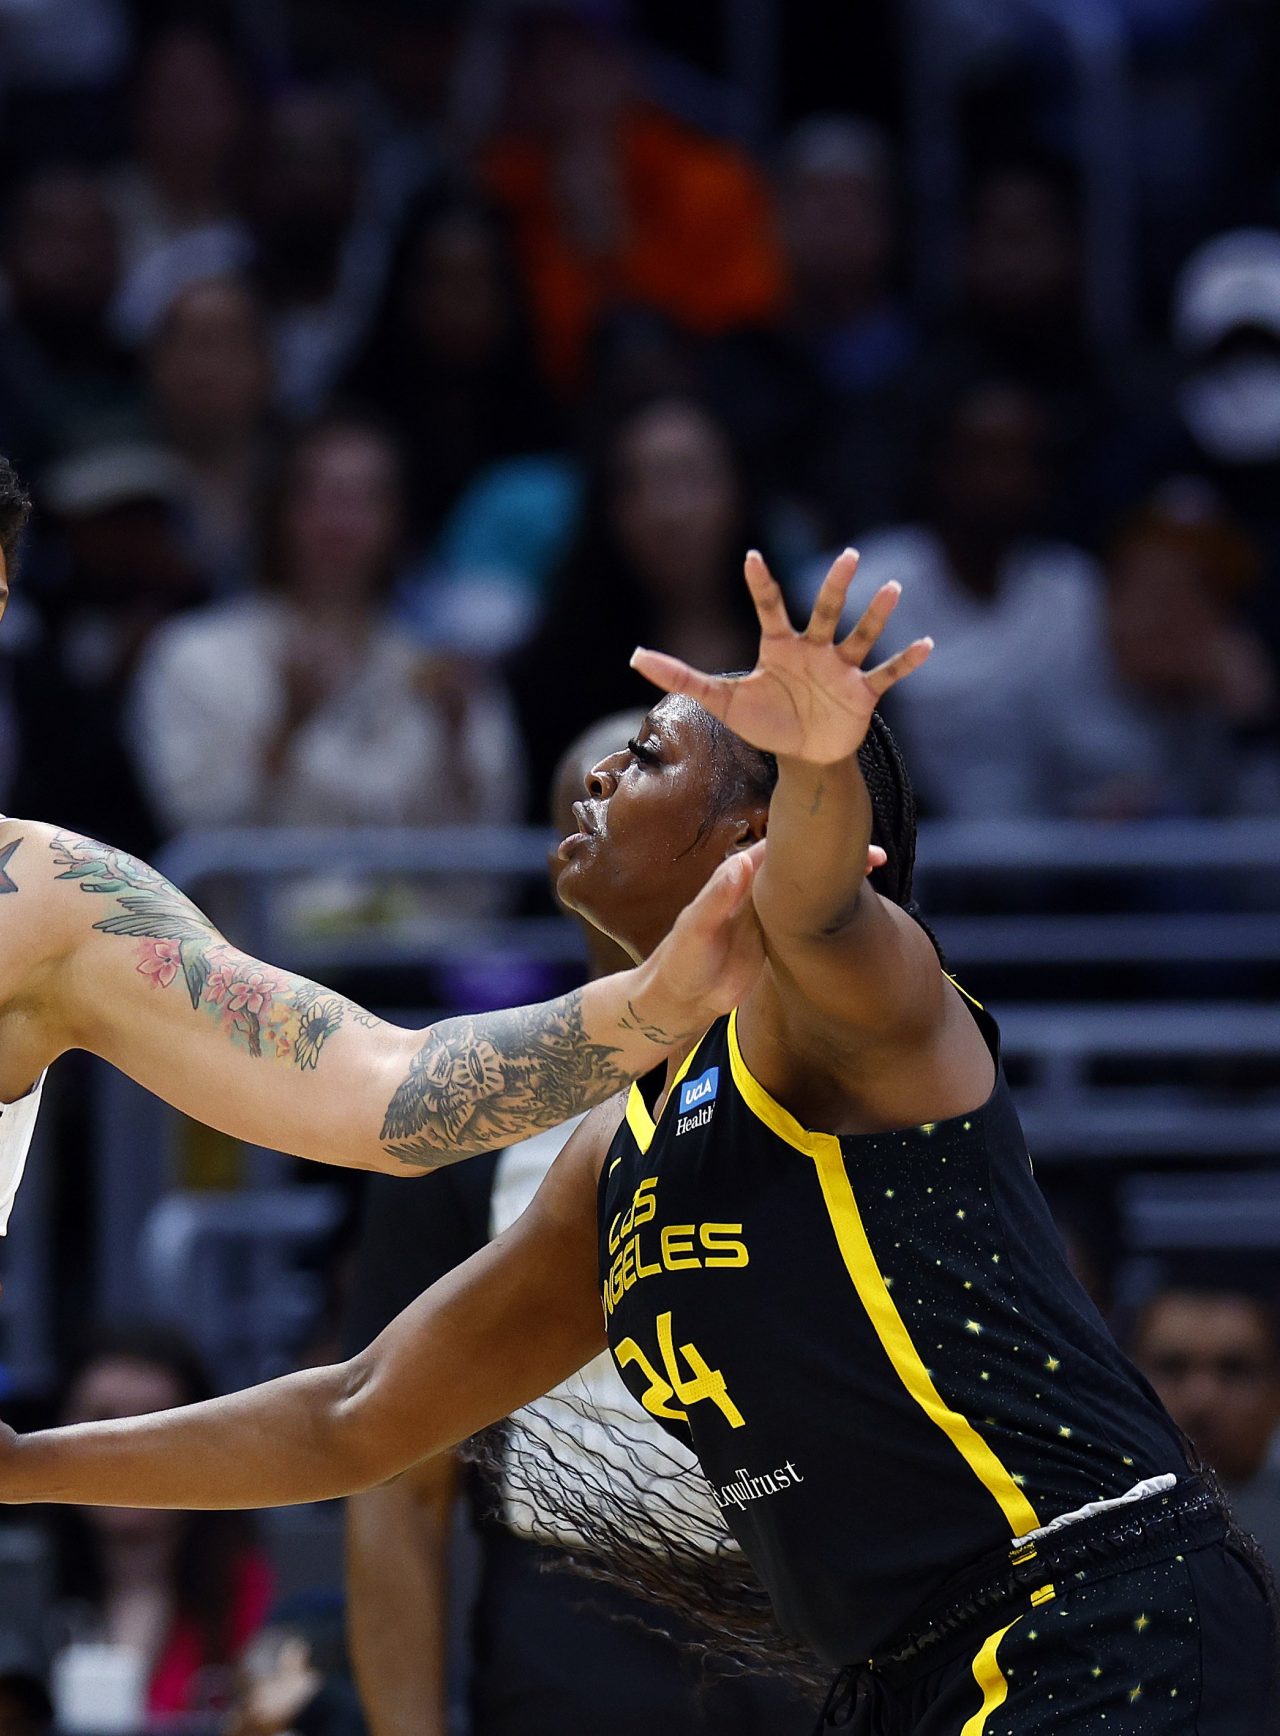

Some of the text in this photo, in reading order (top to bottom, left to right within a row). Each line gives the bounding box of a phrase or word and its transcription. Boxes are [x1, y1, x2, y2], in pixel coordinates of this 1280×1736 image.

[686, 1078, 712, 1105] UCLA
[601, 1222, 750, 1332] NGELES
[614, 1311, 746, 1429] 24
